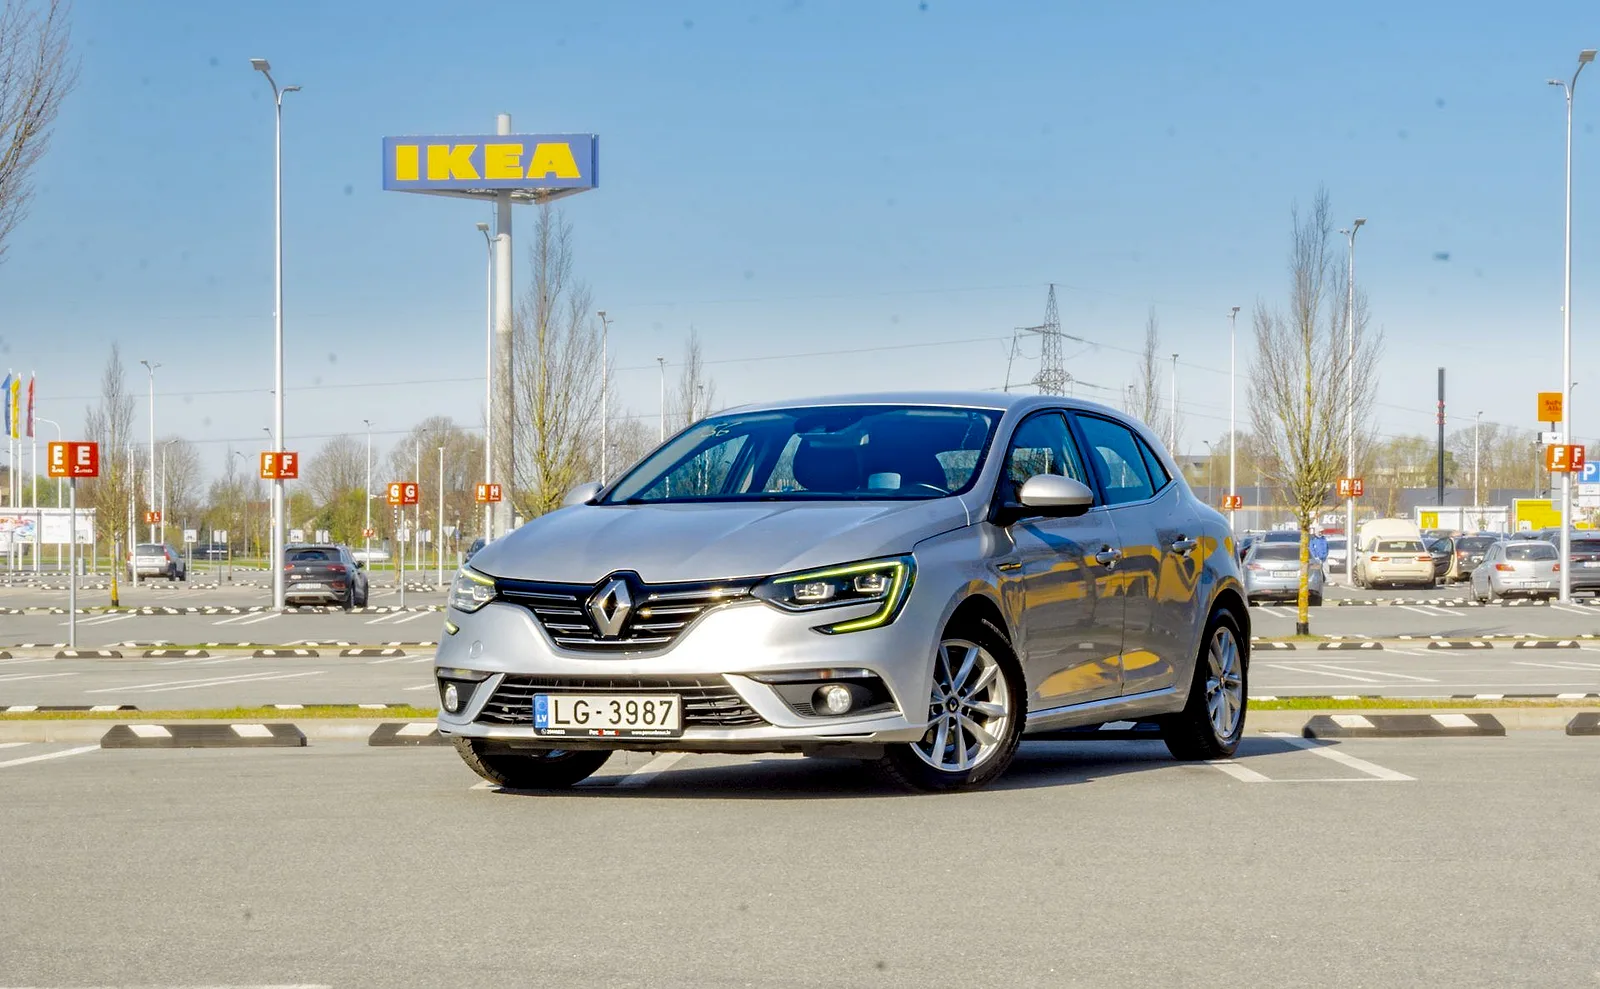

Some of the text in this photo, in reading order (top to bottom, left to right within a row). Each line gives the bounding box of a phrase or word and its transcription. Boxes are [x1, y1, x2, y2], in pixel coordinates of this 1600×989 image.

[395, 142, 582, 181] IKEA
[53, 445, 63, 465] E
[77, 445, 91, 465] E
[265, 454, 273, 470] F
[282, 454, 293, 470] F
[1553, 447, 1564, 463] F
[1573, 447, 1582, 463] F
[1583, 463, 1596, 481] P
[390, 484, 399, 498] G
[405, 484, 415, 498] G
[478, 485, 486, 496] H
[490, 485, 499, 496] H
[1340, 479, 1349, 491] H
[1353, 479, 1362, 491] H
[1322, 514, 1347, 524] KFC
[536, 714, 547, 722] LV
[554, 699, 673, 726] LG-3987
